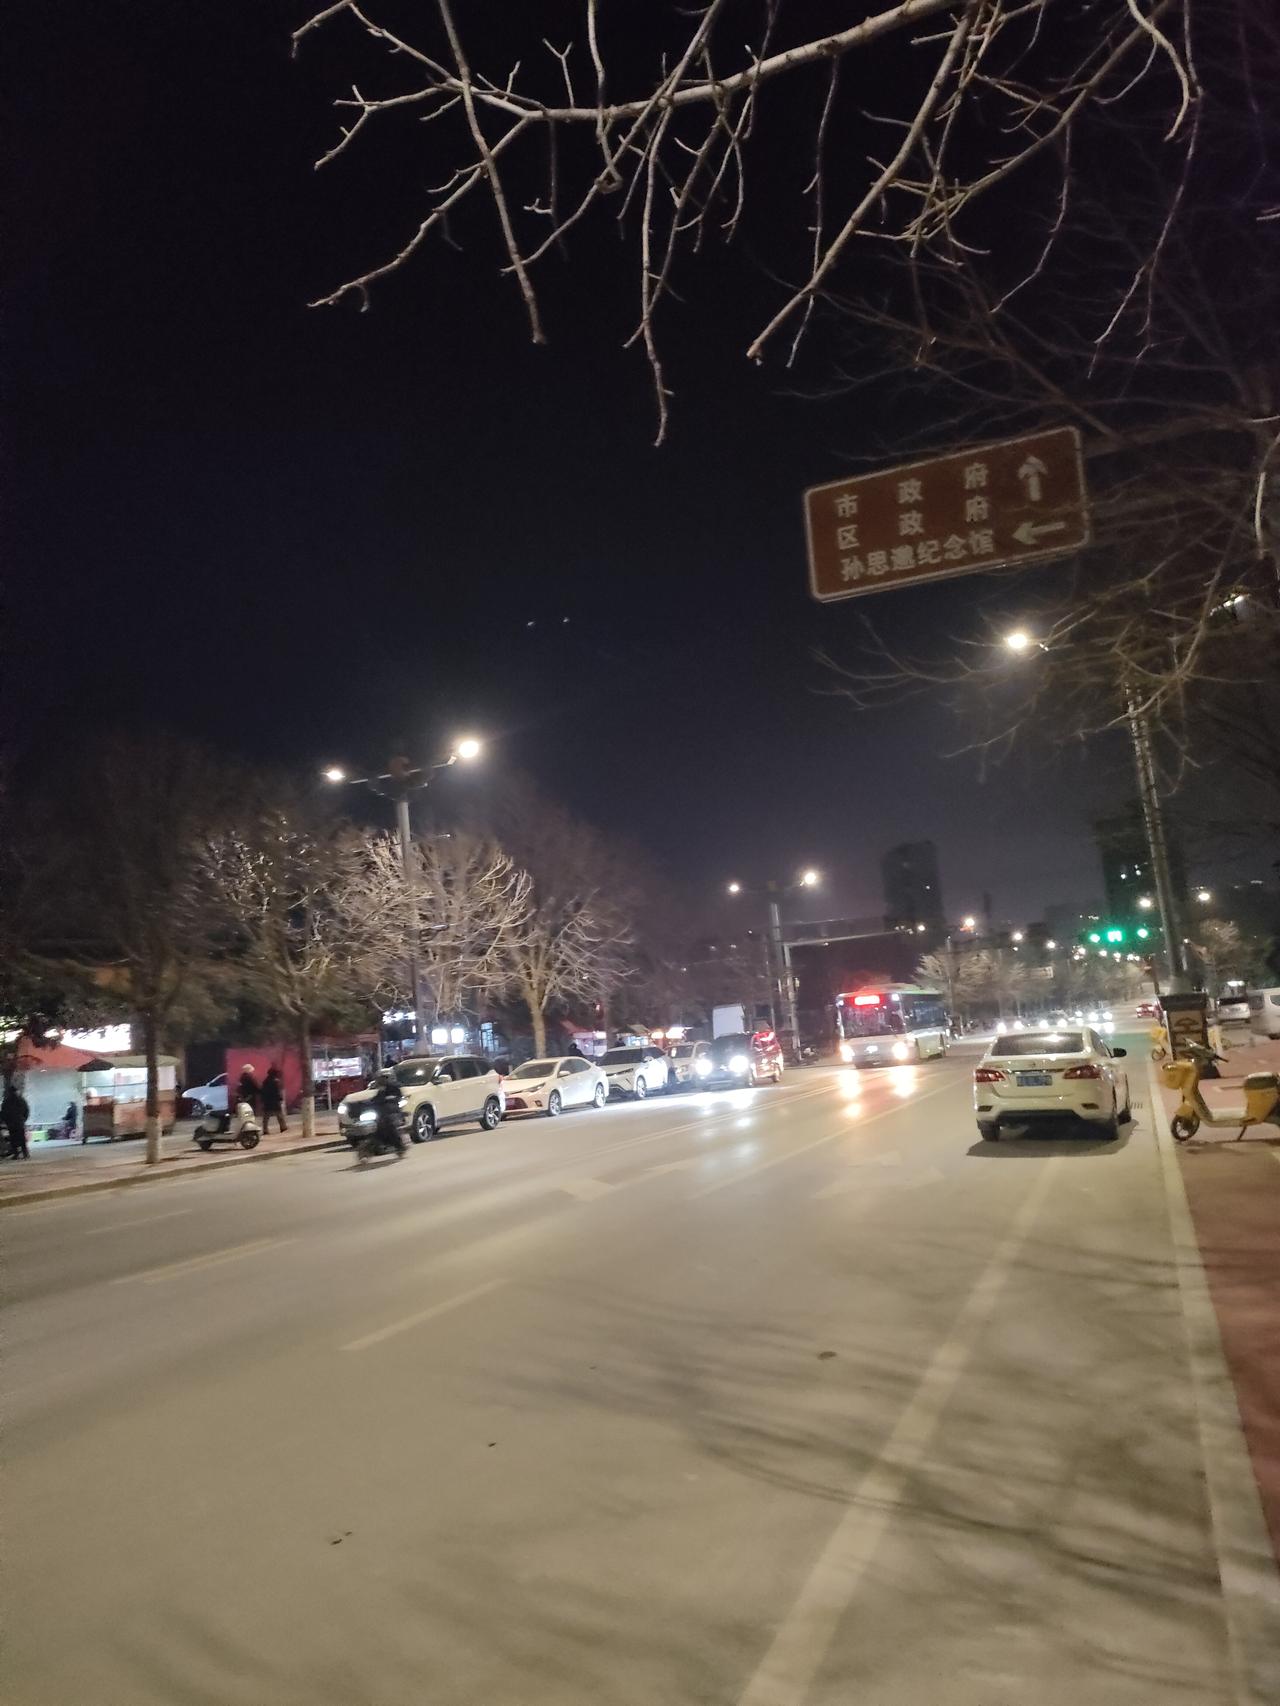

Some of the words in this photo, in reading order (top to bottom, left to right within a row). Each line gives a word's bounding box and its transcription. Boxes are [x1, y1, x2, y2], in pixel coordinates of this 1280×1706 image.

[834, 462, 989, 518] 市政府
[837, 495, 989, 550] 区政府
